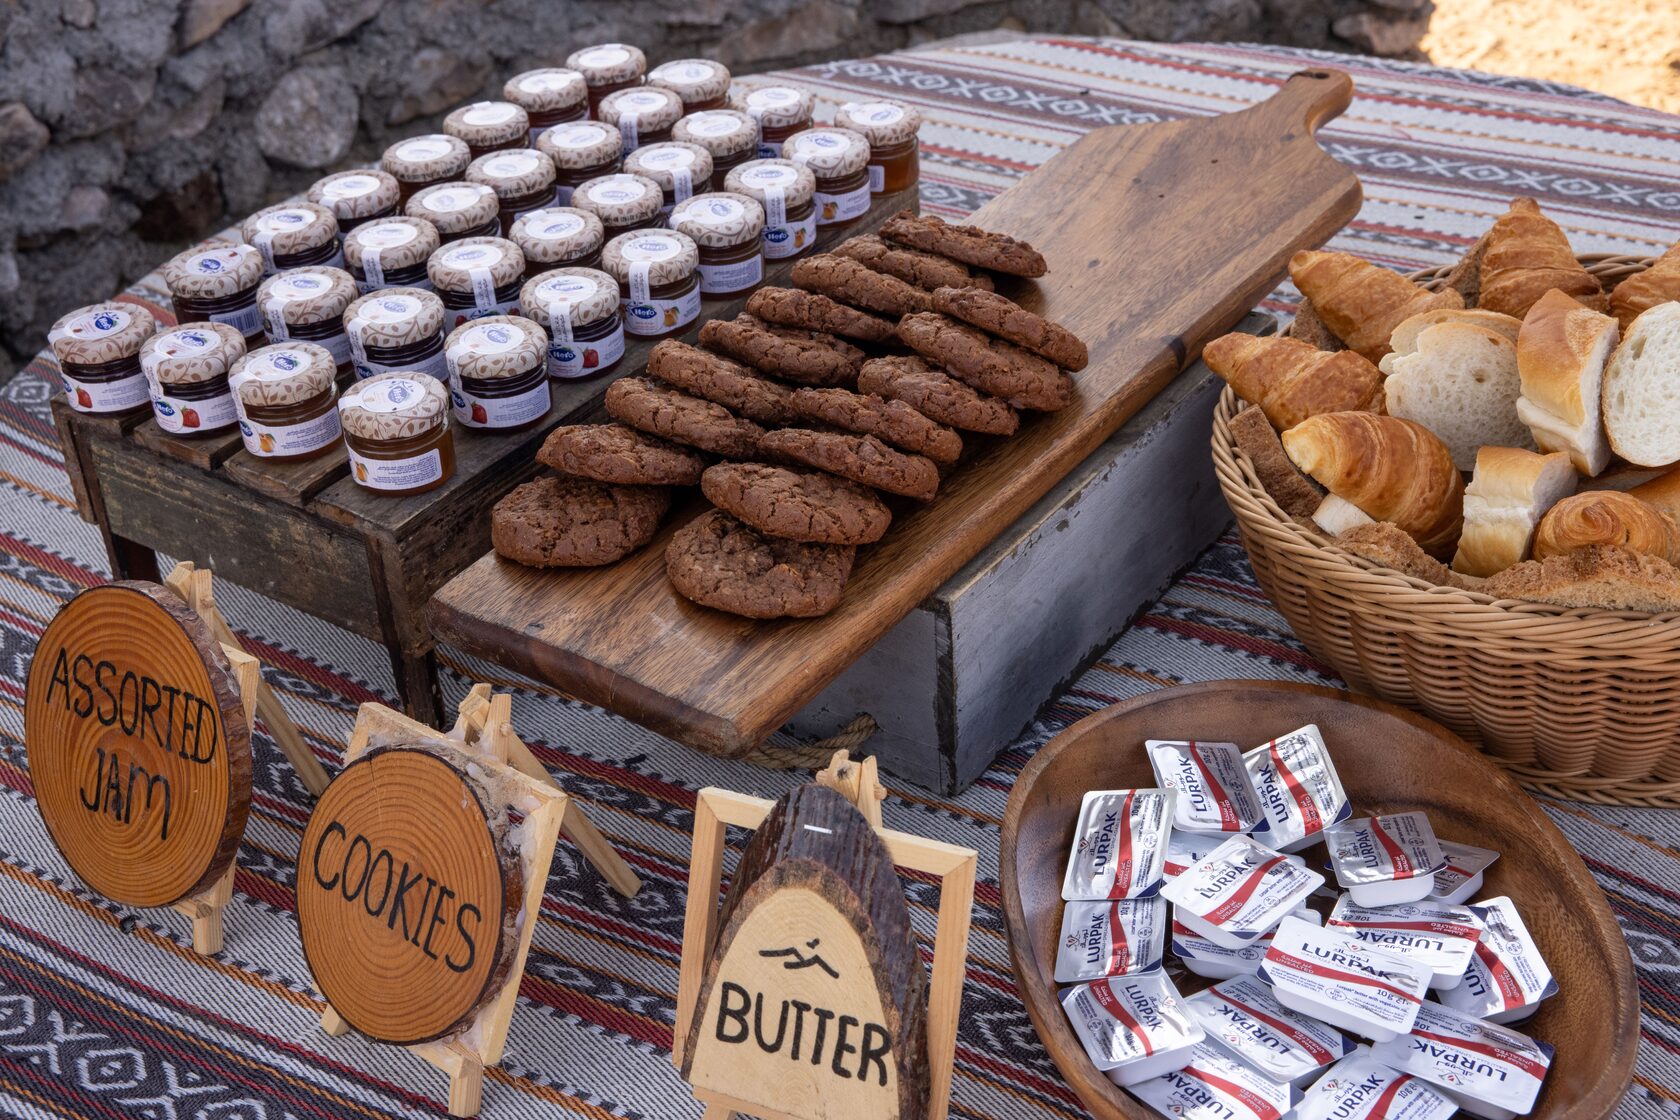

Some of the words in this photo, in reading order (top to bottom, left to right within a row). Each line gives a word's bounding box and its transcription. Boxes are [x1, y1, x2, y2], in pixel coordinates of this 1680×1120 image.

[768, 232, 787, 240] Hero
[635, 309, 655, 317] Hero
[552, 351, 574, 359] Hero
[46, 647, 217, 764] ASSORTED
[1177, 756, 1207, 811] LURPAK
[1258, 763, 1288, 823] LURPAK
[1094, 809, 1117, 874] LURPAK
[1355, 828, 1378, 867] LURPAK
[313, 822, 481, 973] COOKIES
[1199, 857, 1256, 899] LURPAK
[1087, 913, 1104, 962] LURPAK
[1354, 930, 1443, 950] LURPAK
[1430, 922, 1468, 931] UNSALTED
[1274, 956, 1313, 973] UNSALTED
[1301, 942, 1391, 981] LURPAK
[1125, 983, 1162, 1032] LURPAK
[715, 981, 893, 1087] BUTTER
[1216, 1004, 1290, 1054] LURPAK
[1294, 1030, 1325, 1053] UNSALTED
[1413, 1038, 1506, 1081] LURPAK
[1493, 1047, 1534, 1066] UNSALTED
[1162, 1071, 1234, 1120] LURPAK
[1240, 1087, 1270, 1110] UNSALTED
[1327, 1073, 1385, 1120] URPAK
